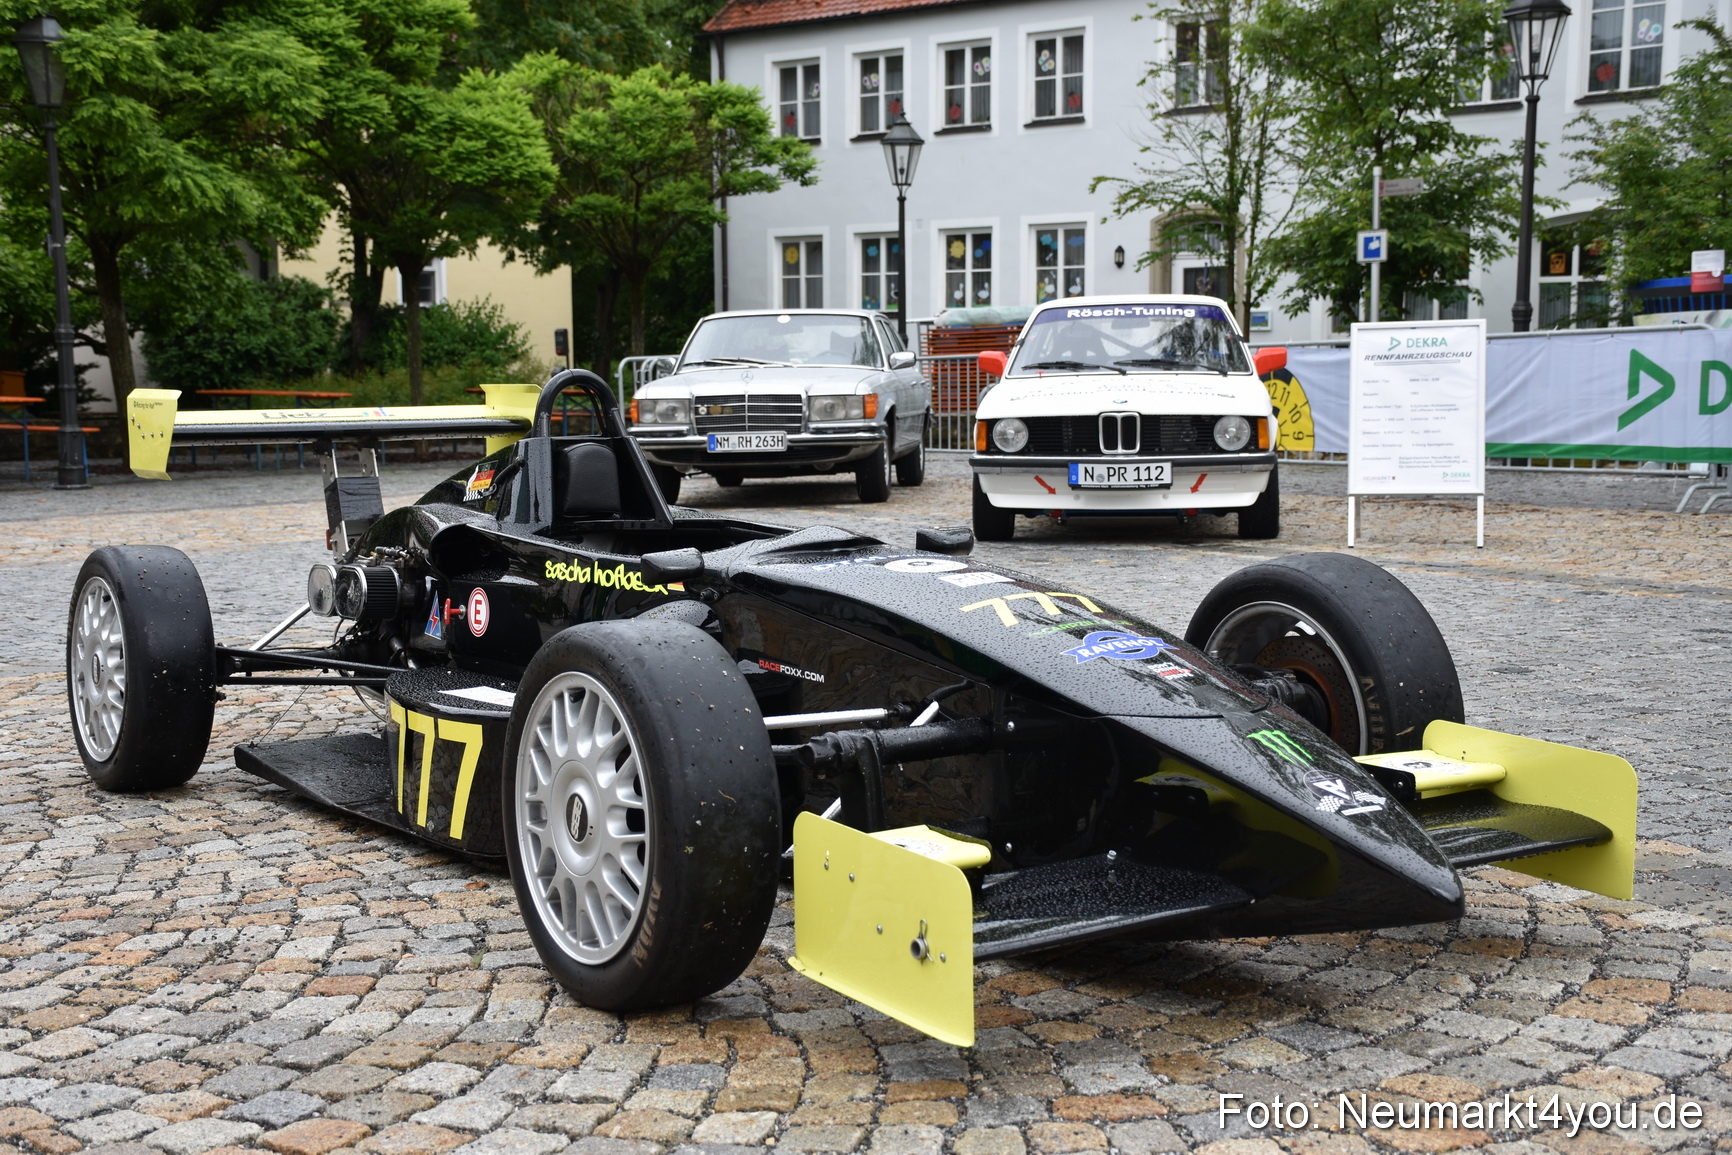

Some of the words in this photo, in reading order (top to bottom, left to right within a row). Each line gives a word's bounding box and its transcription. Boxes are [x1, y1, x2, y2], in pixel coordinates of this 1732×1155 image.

[1067, 307, 1196, 318] Rösch-Tuning
[1406, 337, 1448, 348] DEKRA
[1364, 351, 1473, 361] RENNFAHRZEUGSCHAU
[1279, 387, 1291, 406] 11
[1288, 403, 1302, 424] 10
[715, 436, 730, 449] NM
[737, 435, 753, 449] RH
[755, 435, 784, 448] 263H
[1084, 466, 1095, 482] N
[1106, 466, 1128, 482] PR
[1133, 465, 1165, 481] 112
[545, 558, 591, 583] sascha
[474, 599, 483, 625] E
[959, 592, 1104, 627] 777
[1077, 638, 1160, 658] RAVENOL
[758, 659, 825, 683] RACEFOXX.COM
[390, 701, 483, 840] 777
[571, 796, 583, 840] BBS
